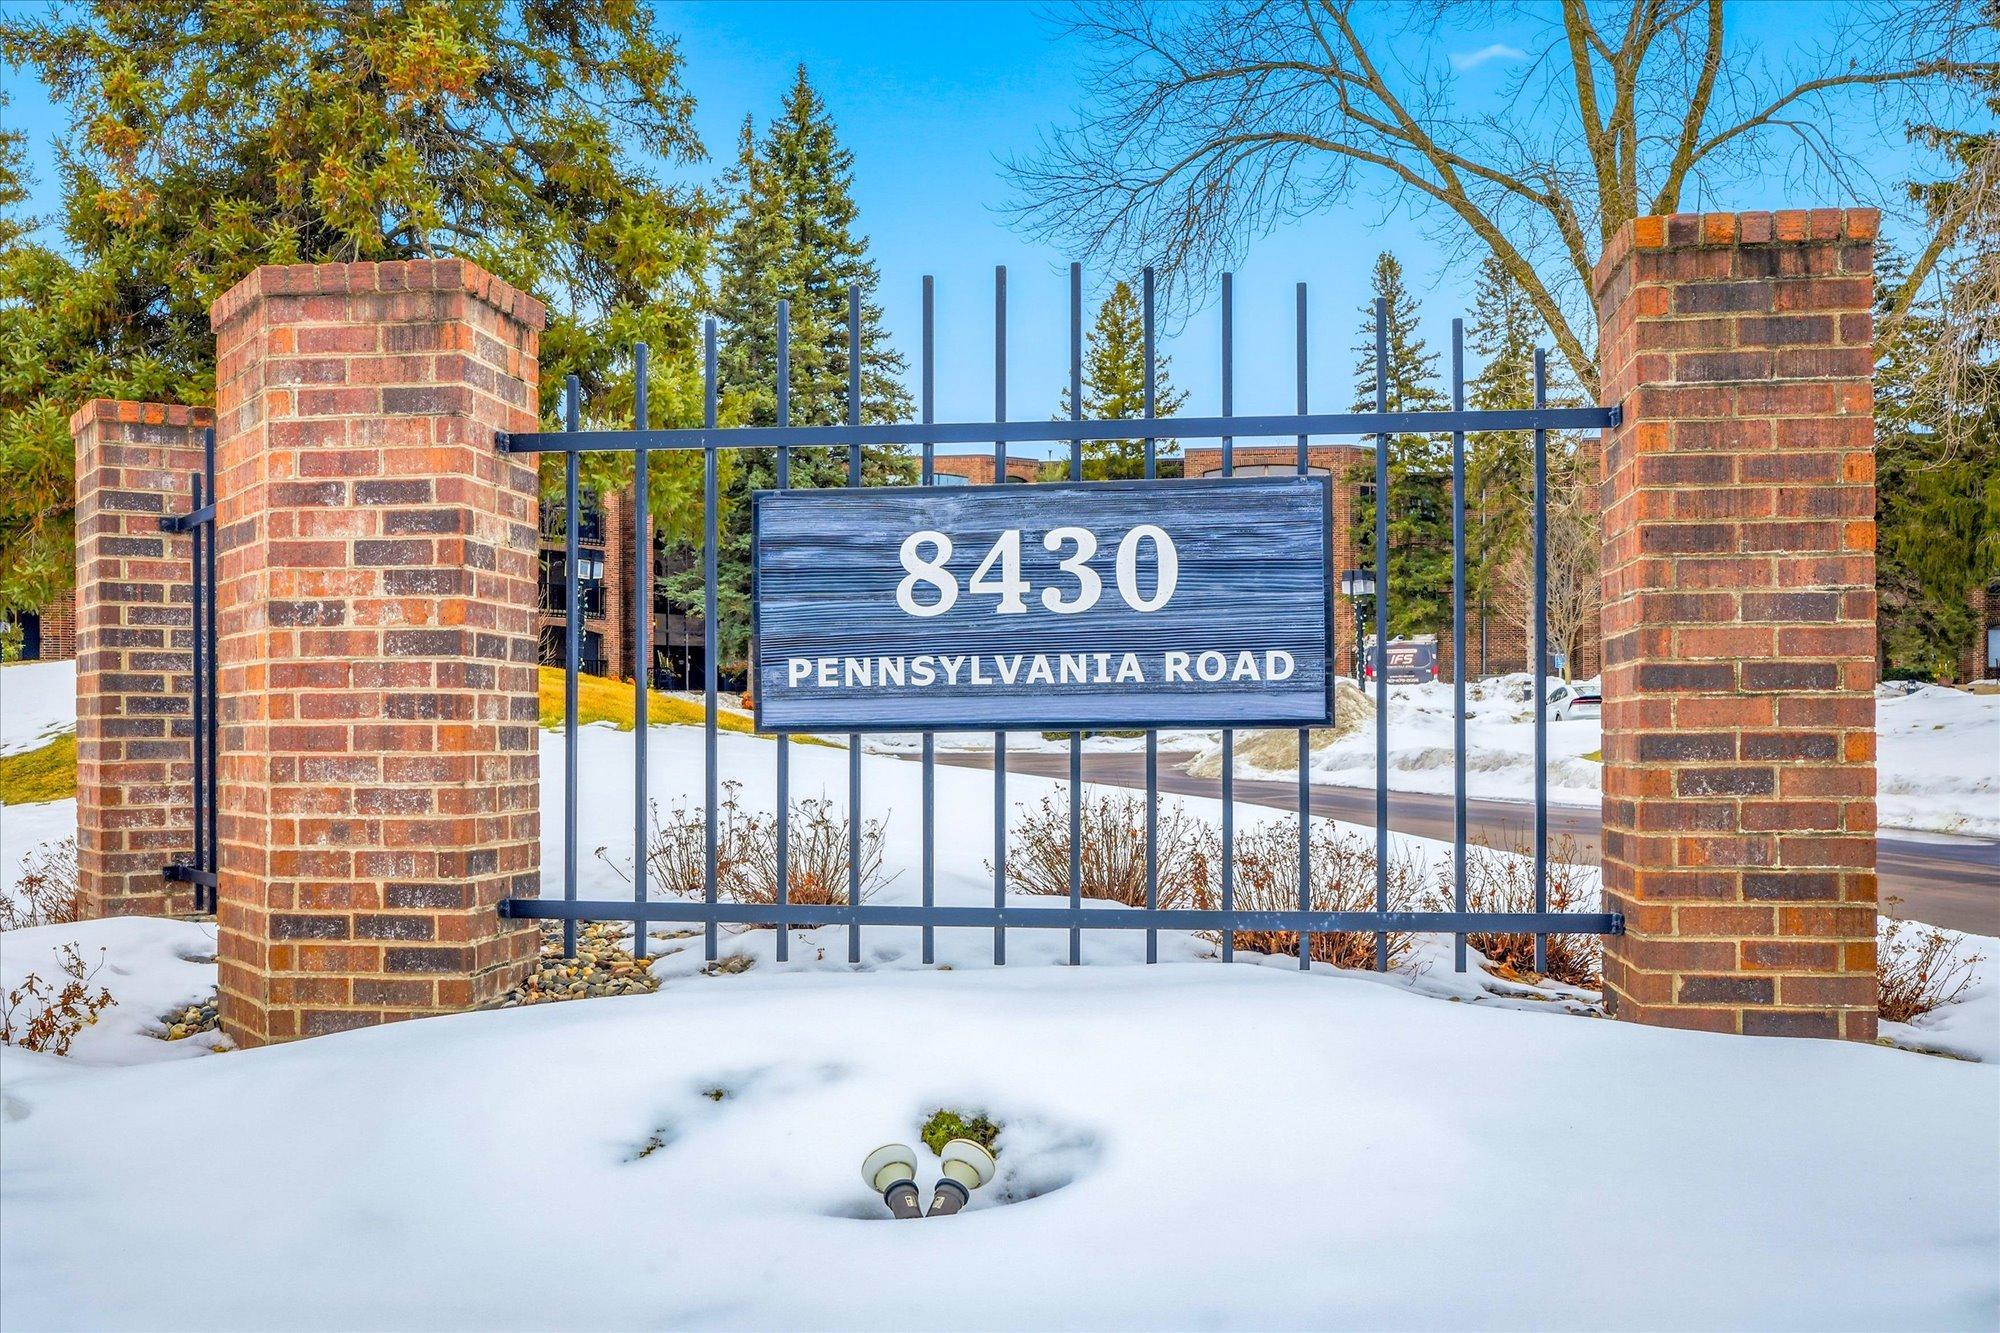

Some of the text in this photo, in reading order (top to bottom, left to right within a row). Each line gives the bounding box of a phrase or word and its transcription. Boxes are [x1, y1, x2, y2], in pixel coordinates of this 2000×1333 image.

[895, 525, 1179, 617] 8430
[788, 650, 1295, 688] PENNSYLVANIA ROAD
[1390, 654, 1414, 665] IFS
